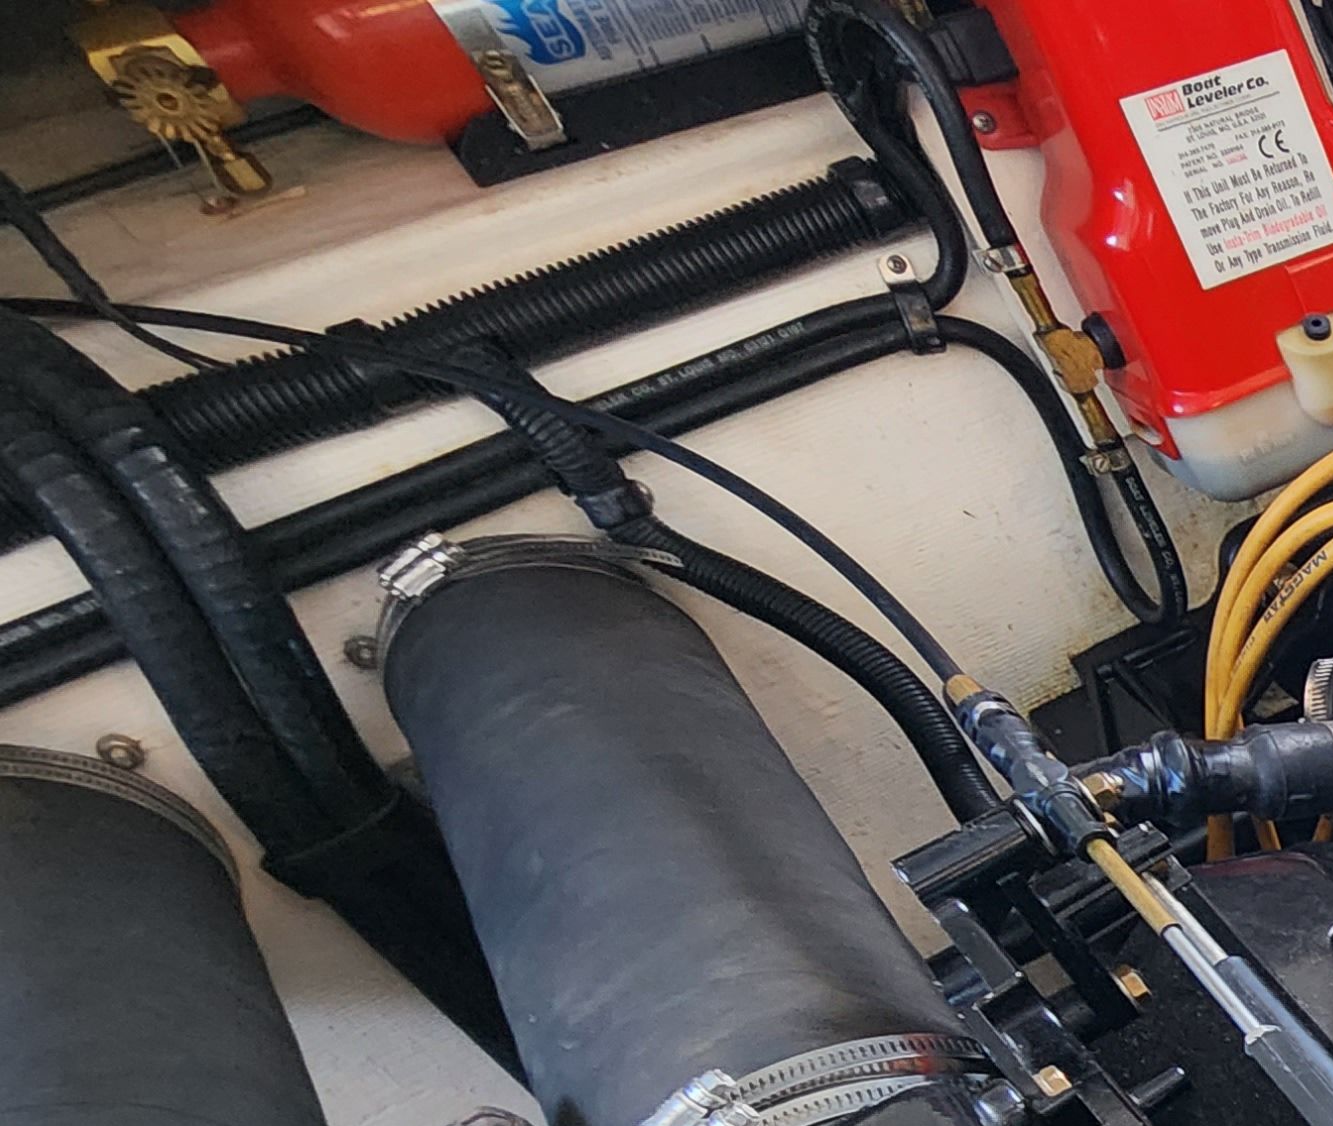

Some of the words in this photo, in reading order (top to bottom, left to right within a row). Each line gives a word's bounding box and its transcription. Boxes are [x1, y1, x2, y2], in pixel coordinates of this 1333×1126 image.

[1181, 74, 1224, 97] Boat
[1185, 80, 1246, 110] Leveler
[1245, 73, 1269, 92] Co.
[1191, 205, 1209, 222] The
[1208, 195, 1239, 218] Factory
[1239, 190, 1255, 206] For
[1254, 184, 1272, 202] Any
[1270, 173, 1303, 196] Reason,
[1192, 183, 1212, 201] This
[1211, 177, 1230, 195] Unit
[1229, 170, 1251, 188] Must
[1250, 166, 1262, 181] Be
[1262, 154, 1298, 178] Returned
[1297, 150, 1309, 165] To
[1200, 223, 1222, 239] move
[1221, 214, 1241, 234] Plug
[1238, 208, 1256, 224] And
[1254, 201, 1278, 220] Drain
[1299, 185, 1322, 204] Refill
[1206, 240, 1224, 257] Use
[1223, 226, 1262, 250] Insta-Trim
[1261, 209, 1316, 239] Biodegradable
[1214, 258, 1226, 274] Or
[1226, 252, 1244, 271] Any
[1243, 245, 1264, 265] Type
[1263, 228, 1313, 255] Transmission
[1262, 550, 1329, 623] MAGSTAR
